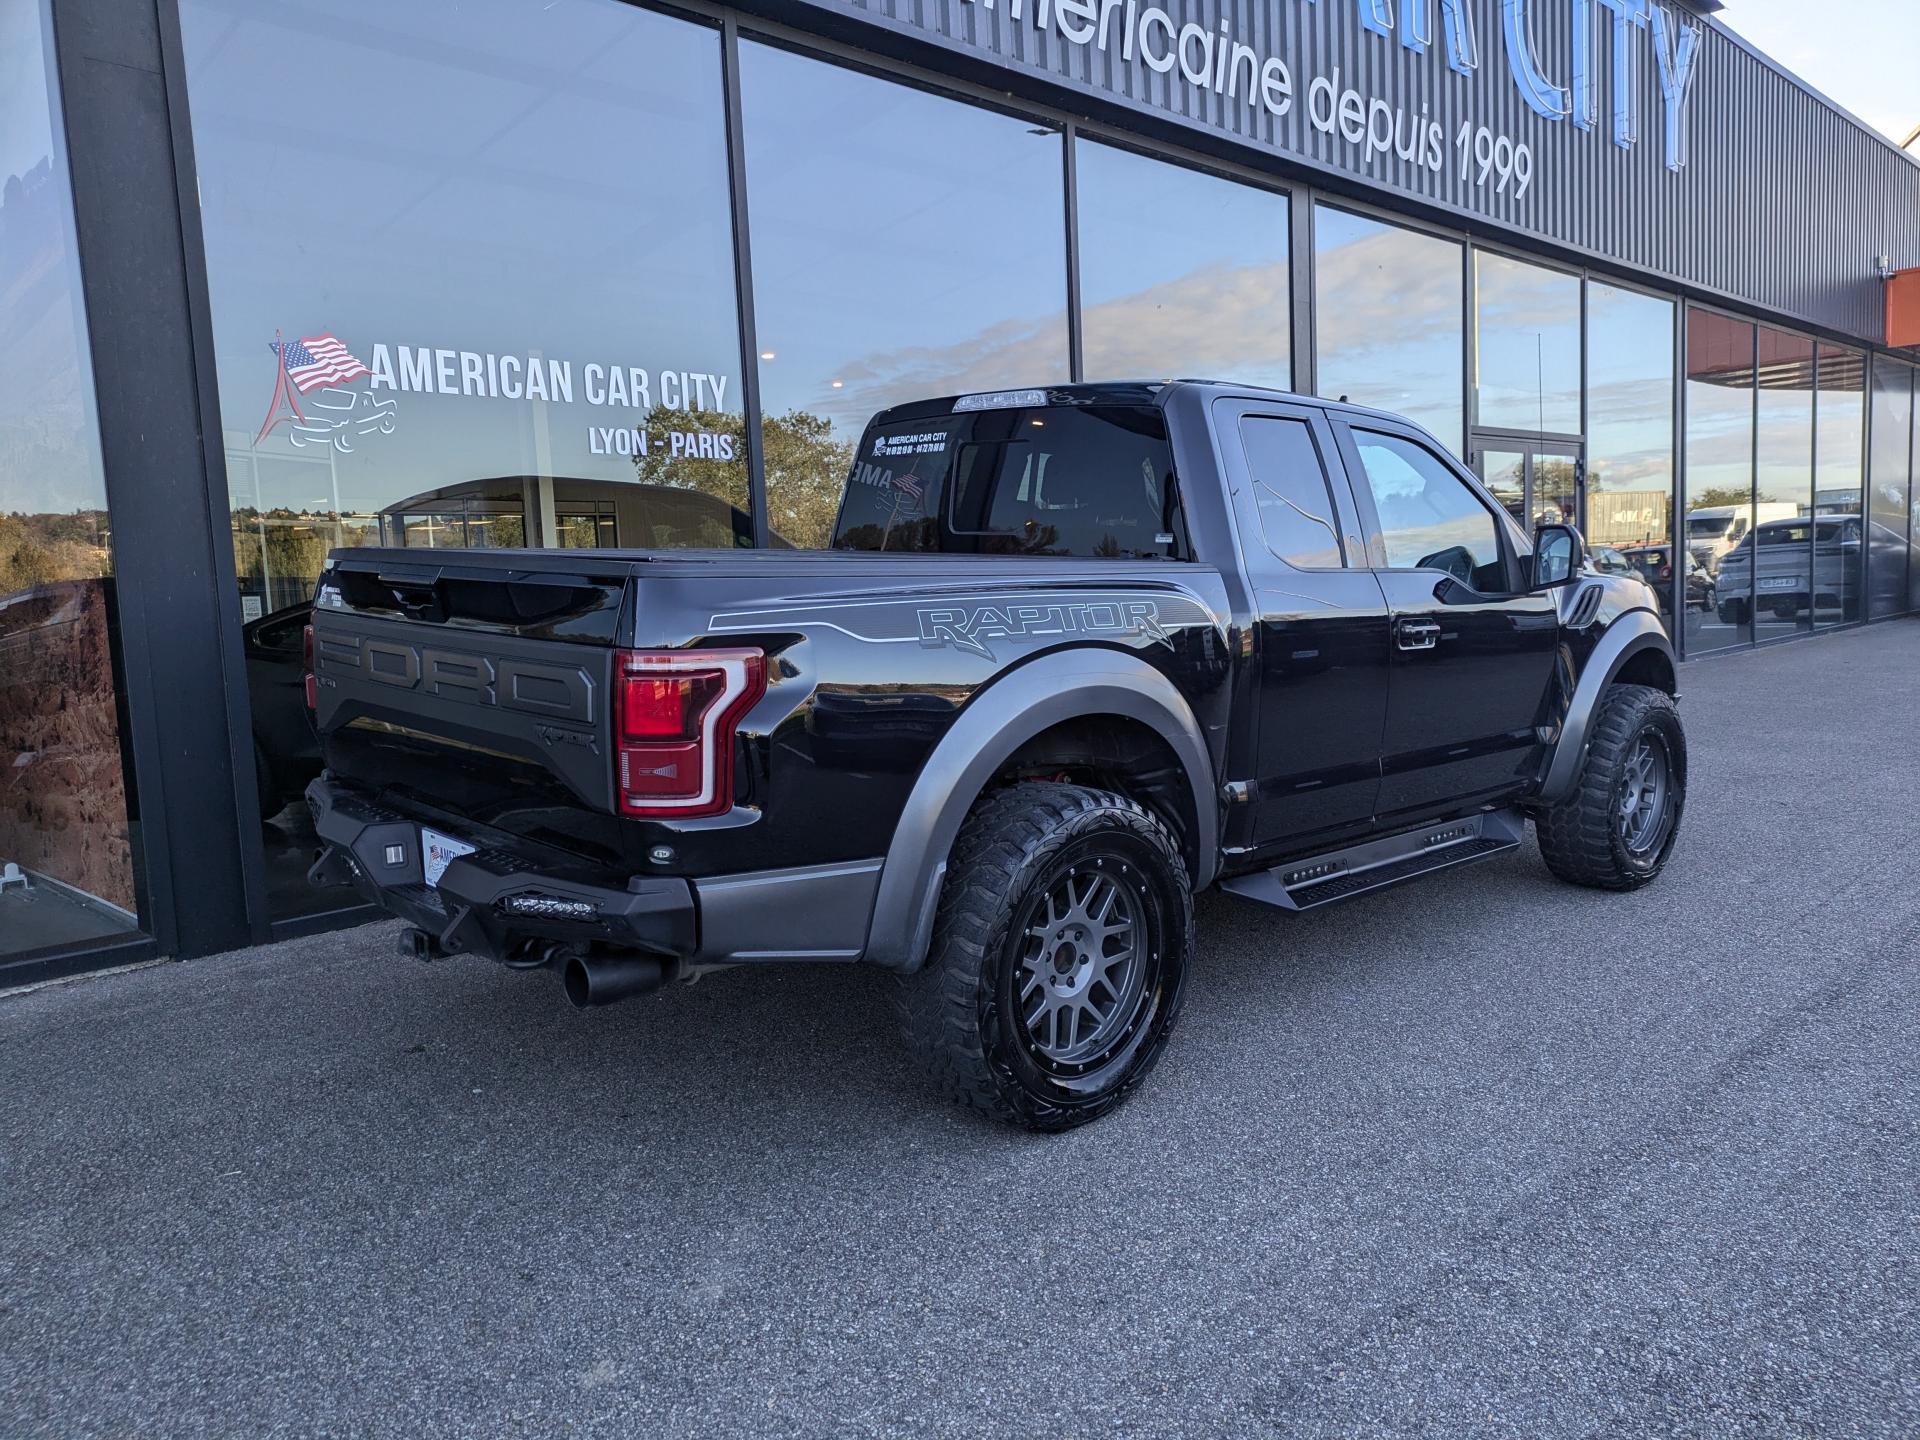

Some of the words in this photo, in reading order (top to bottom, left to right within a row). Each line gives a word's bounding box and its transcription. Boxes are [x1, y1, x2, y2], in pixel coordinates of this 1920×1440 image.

[1308, 66, 1443, 172] depuis
[1456, 120, 1532, 199] 1999
[370, 343, 574, 403] AMERICAN
[584, 363, 651, 409] CAR
[660, 370, 728, 414] CITY
[588, 426, 649, 456] LYON
[670, 431, 734, 461] PARIS
[888, 435, 918, 445] AMERICAN
[919, 433, 932, 442] CAR
[933, 432, 947, 441] CITY
[917, 601, 1175, 662] RAPTOR
[318, 629, 597, 723] FORD
